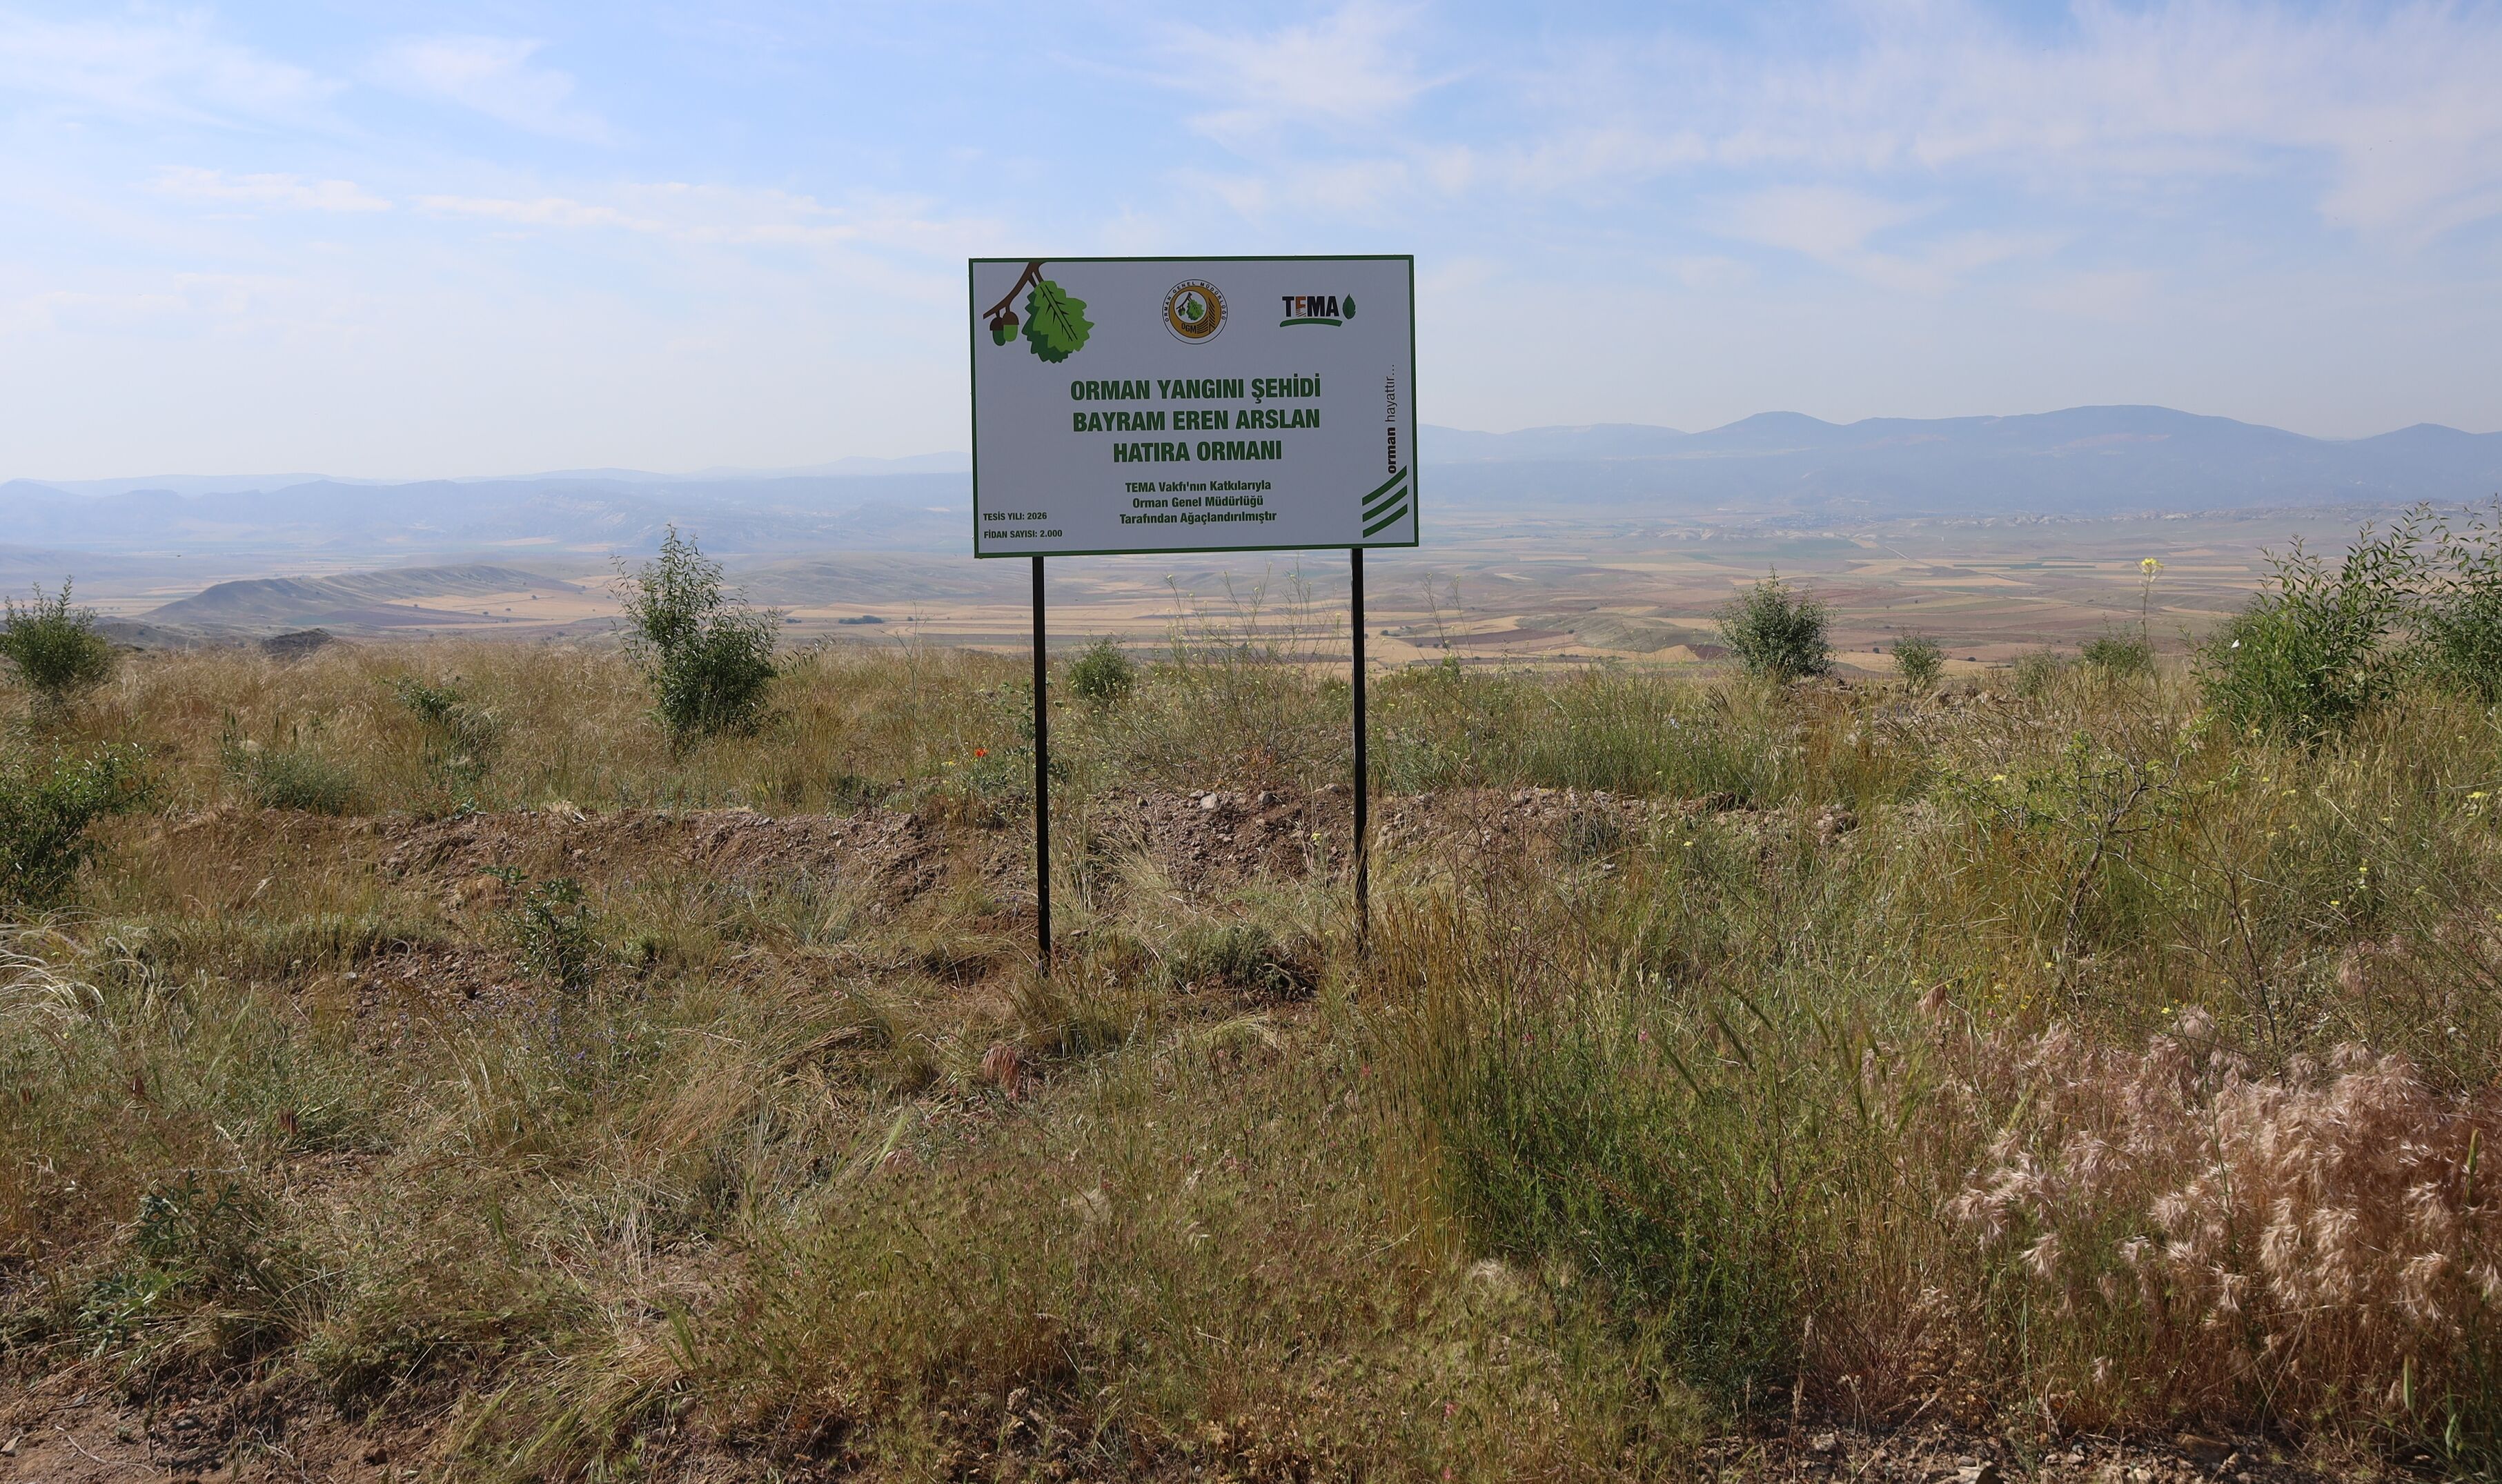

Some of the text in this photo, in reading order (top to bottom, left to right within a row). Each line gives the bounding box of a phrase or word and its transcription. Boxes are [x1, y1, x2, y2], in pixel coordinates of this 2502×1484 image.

[1173, 281, 1195, 293] GENEL
[1282, 296, 1339, 317] TEMA
[1181, 324, 1197, 334] OGM
[1071, 373, 1321, 404] ORMAN YANGINI ŞEHİDİ
[1073, 409, 1319, 431] BAYRAM EREN ARSLAN
[1385, 364, 1397, 474] orman hayattır...
[1114, 441, 1281, 462] HATIRA ORMANI
[1125, 480, 1271, 493] TEMA Vakfı'nın Katkılarıyla
[1133, 495, 1263, 508] Orman Genel Müdürlüğü
[983, 511, 1005, 520] TESİS
[1120, 511, 1277, 525] Tarafından Ağaçlandırılmıştır
[984, 530, 1007, 538] FİDAN
